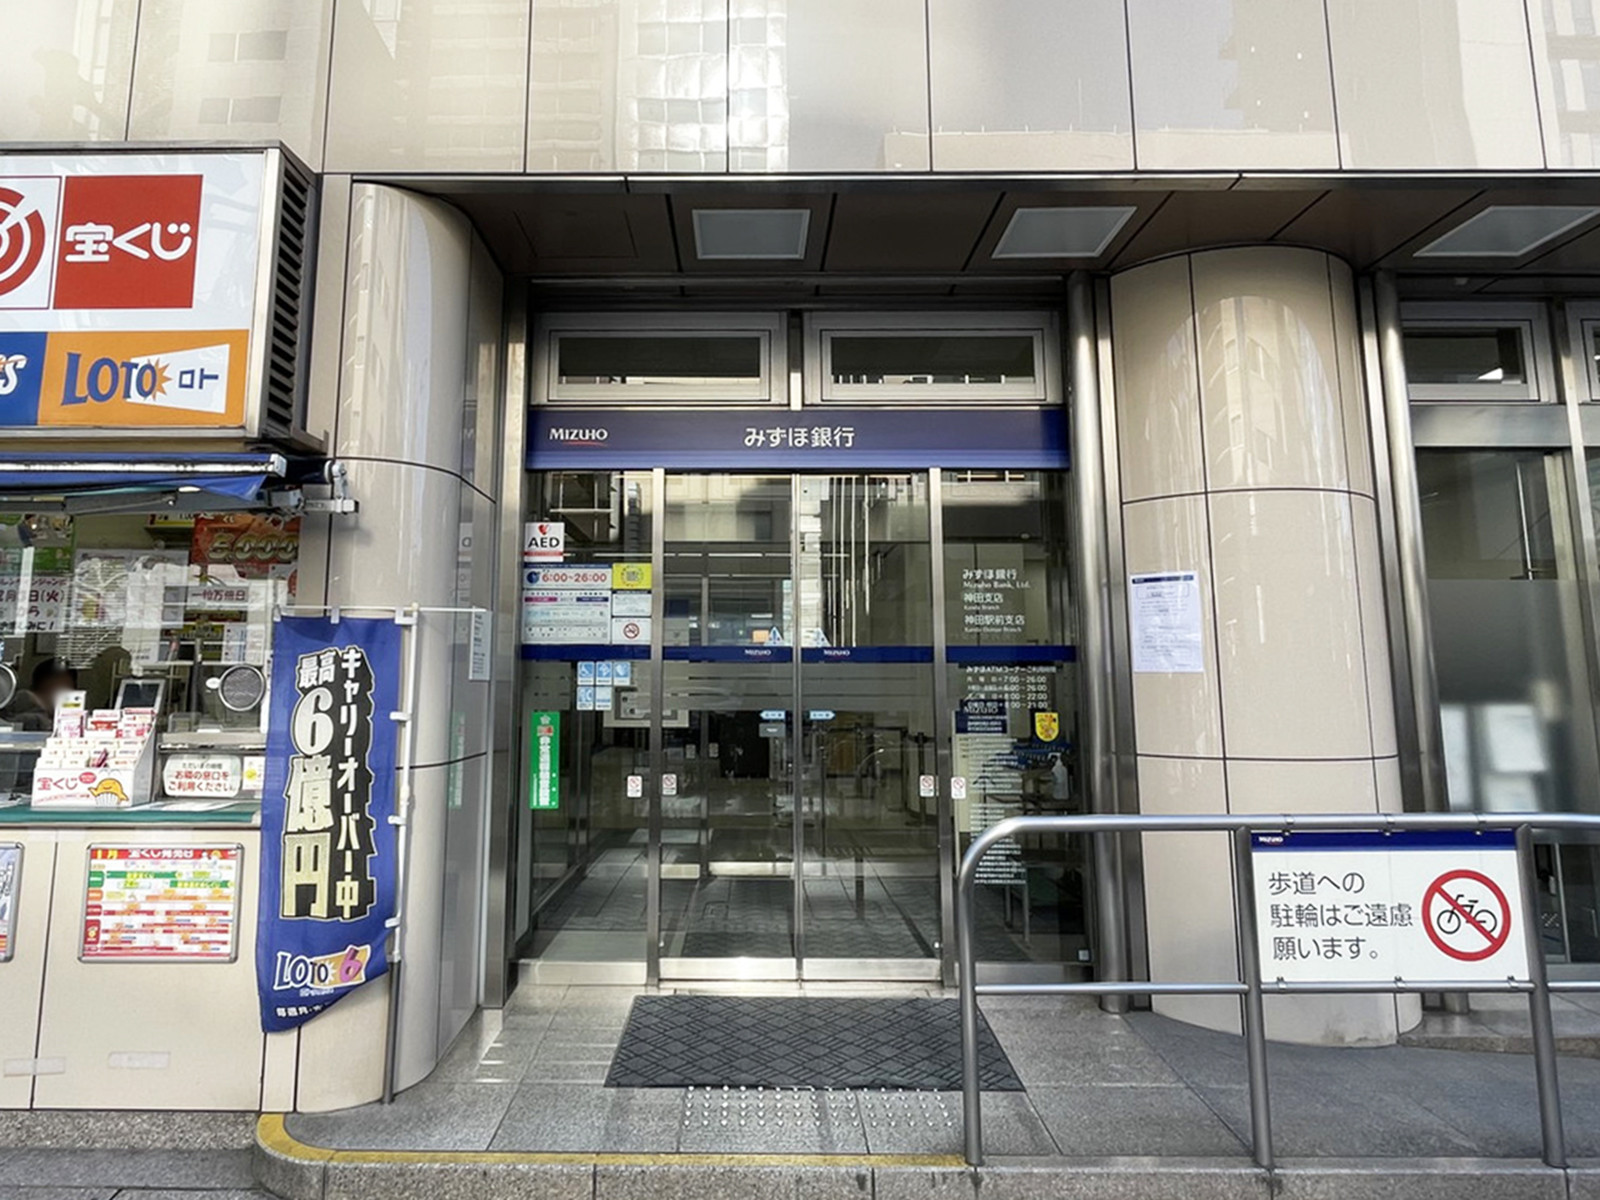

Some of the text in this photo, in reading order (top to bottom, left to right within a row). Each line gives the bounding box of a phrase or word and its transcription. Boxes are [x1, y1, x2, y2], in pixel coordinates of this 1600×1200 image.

[65, 222, 192, 262] 宝くじ
[61, 352, 157, 406] LOTO
[549, 427, 608, 441] MIZUHO
[744, 426, 855, 448] みずほ銀行
[528, 537, 560, 548] AED
[962, 569, 1017, 580] みずほ銀行
[963, 593, 1003, 603] 神田支店
[964, 615, 1025, 626] 神田駅前支店
[37, 778, 78, 791] 宝くじ
[336, 649, 362, 918] キャリーオーバー中
[1268, 872, 1366, 896] 歩道への
[1270, 903, 1414, 928] 駐輪はご遠慮
[1272, 936, 1379, 961] 願います。
